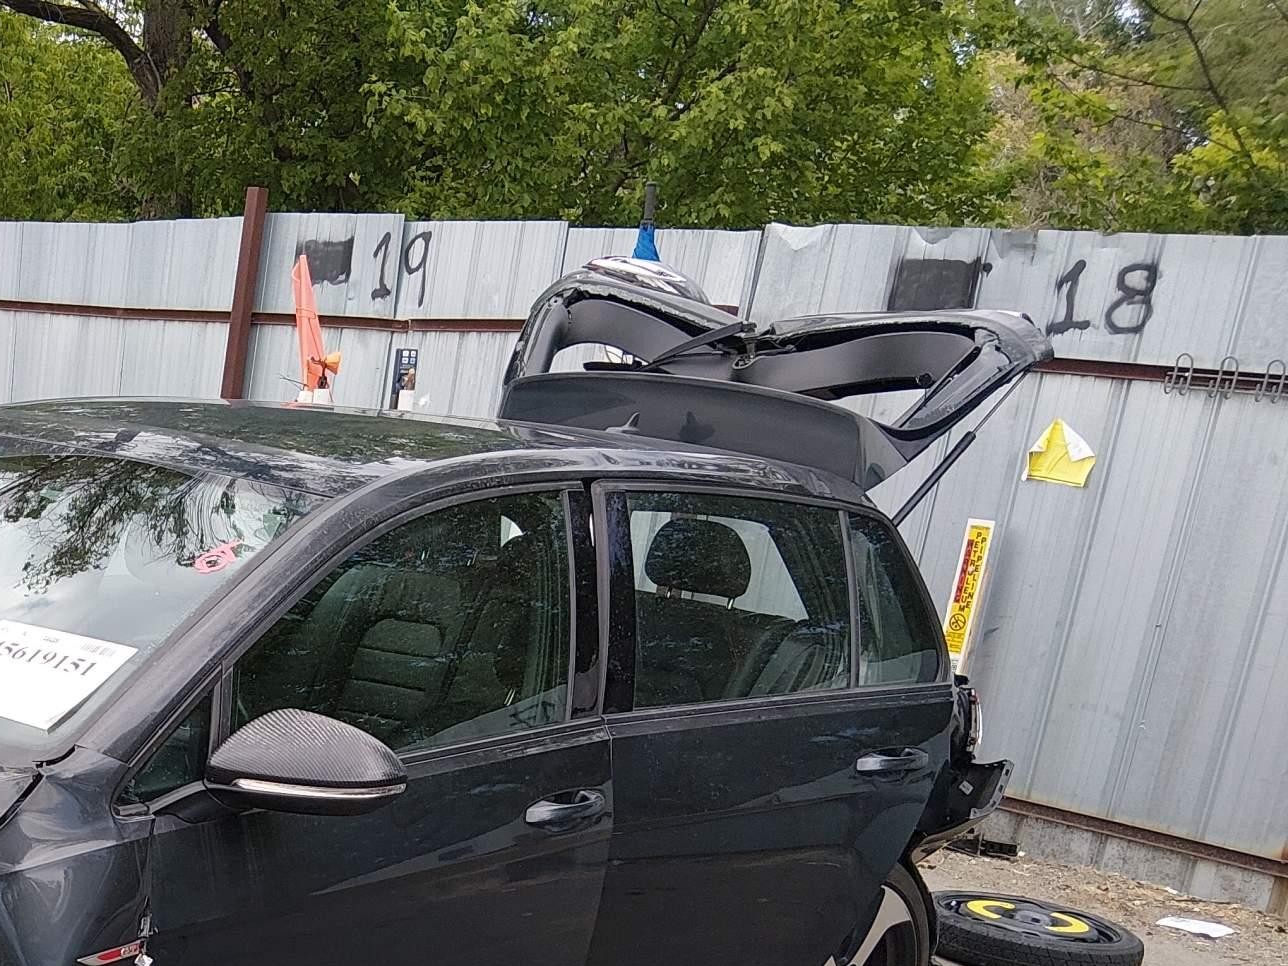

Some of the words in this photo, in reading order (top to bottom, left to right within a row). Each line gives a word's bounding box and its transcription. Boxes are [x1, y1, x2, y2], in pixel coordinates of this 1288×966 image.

[371, 231, 432, 308] 19
[1045, 259, 1158, 337] 18
[965, 537, 987, 609] PIPELINE
